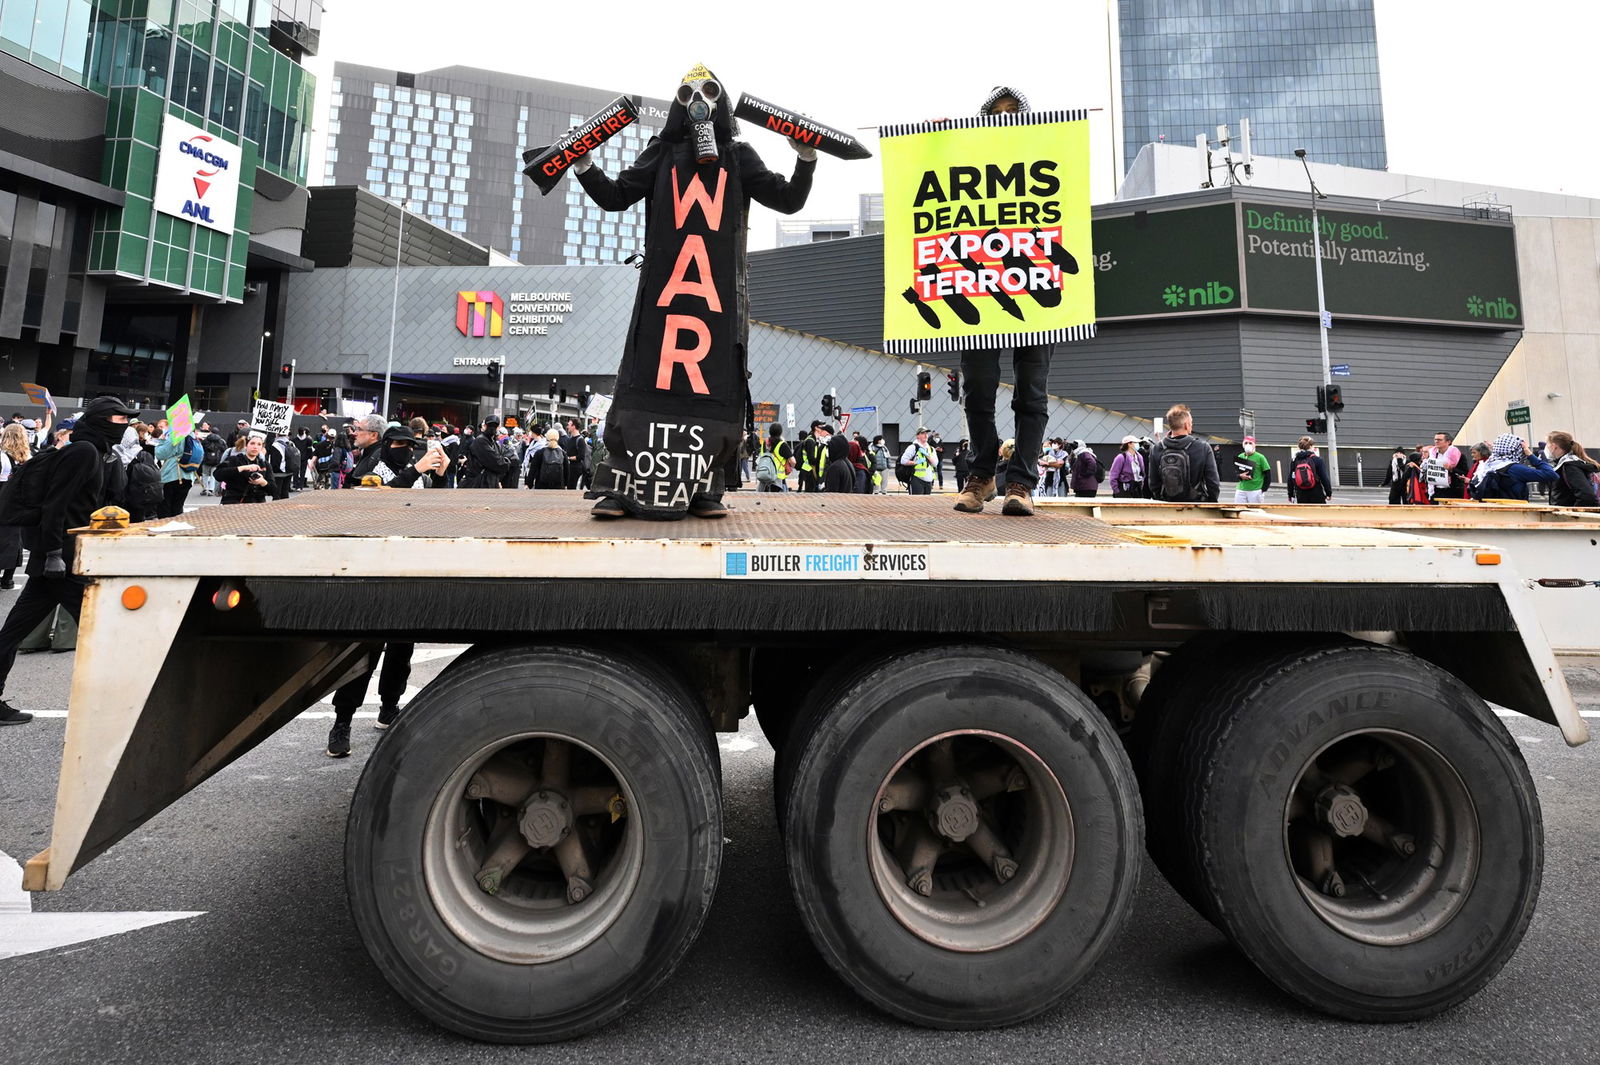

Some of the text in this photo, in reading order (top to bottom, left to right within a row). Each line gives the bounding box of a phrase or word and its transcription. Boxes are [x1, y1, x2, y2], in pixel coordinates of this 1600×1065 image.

[558, 103, 624, 151] UNCONDITIONAL
[743, 96, 853, 146] IMMEDIATE PERMENANT
[765, 115, 823, 148] NOW!
[179, 141, 229, 170] CMA CGM
[542, 108, 633, 176] CEASEFIRE
[912, 160, 1061, 207] ARMS
[181, 200, 214, 223] ANL
[914, 201, 1062, 234] DEALERS
[1340, 222, 1389, 242] good.
[917, 230, 1060, 266] EXPORT
[1350, 246, 1430, 272] amazing.
[655, 164, 728, 395] WAR
[916, 264, 1061, 298] TERROR!
[1188, 281, 1234, 306] nib
[510, 303, 573, 313] CONVENTION
[511, 292, 572, 302] MELBOURNE
[1486, 297, 1518, 320] nib
[509, 314, 563, 324] EXHIBITION
[509, 326, 548, 336] CENTRE
[648, 422, 704, 451] IT'S
[626, 450, 714, 480] OSTIN
[751, 554, 926, 572] BUTLER FREIGHT SERVICES
